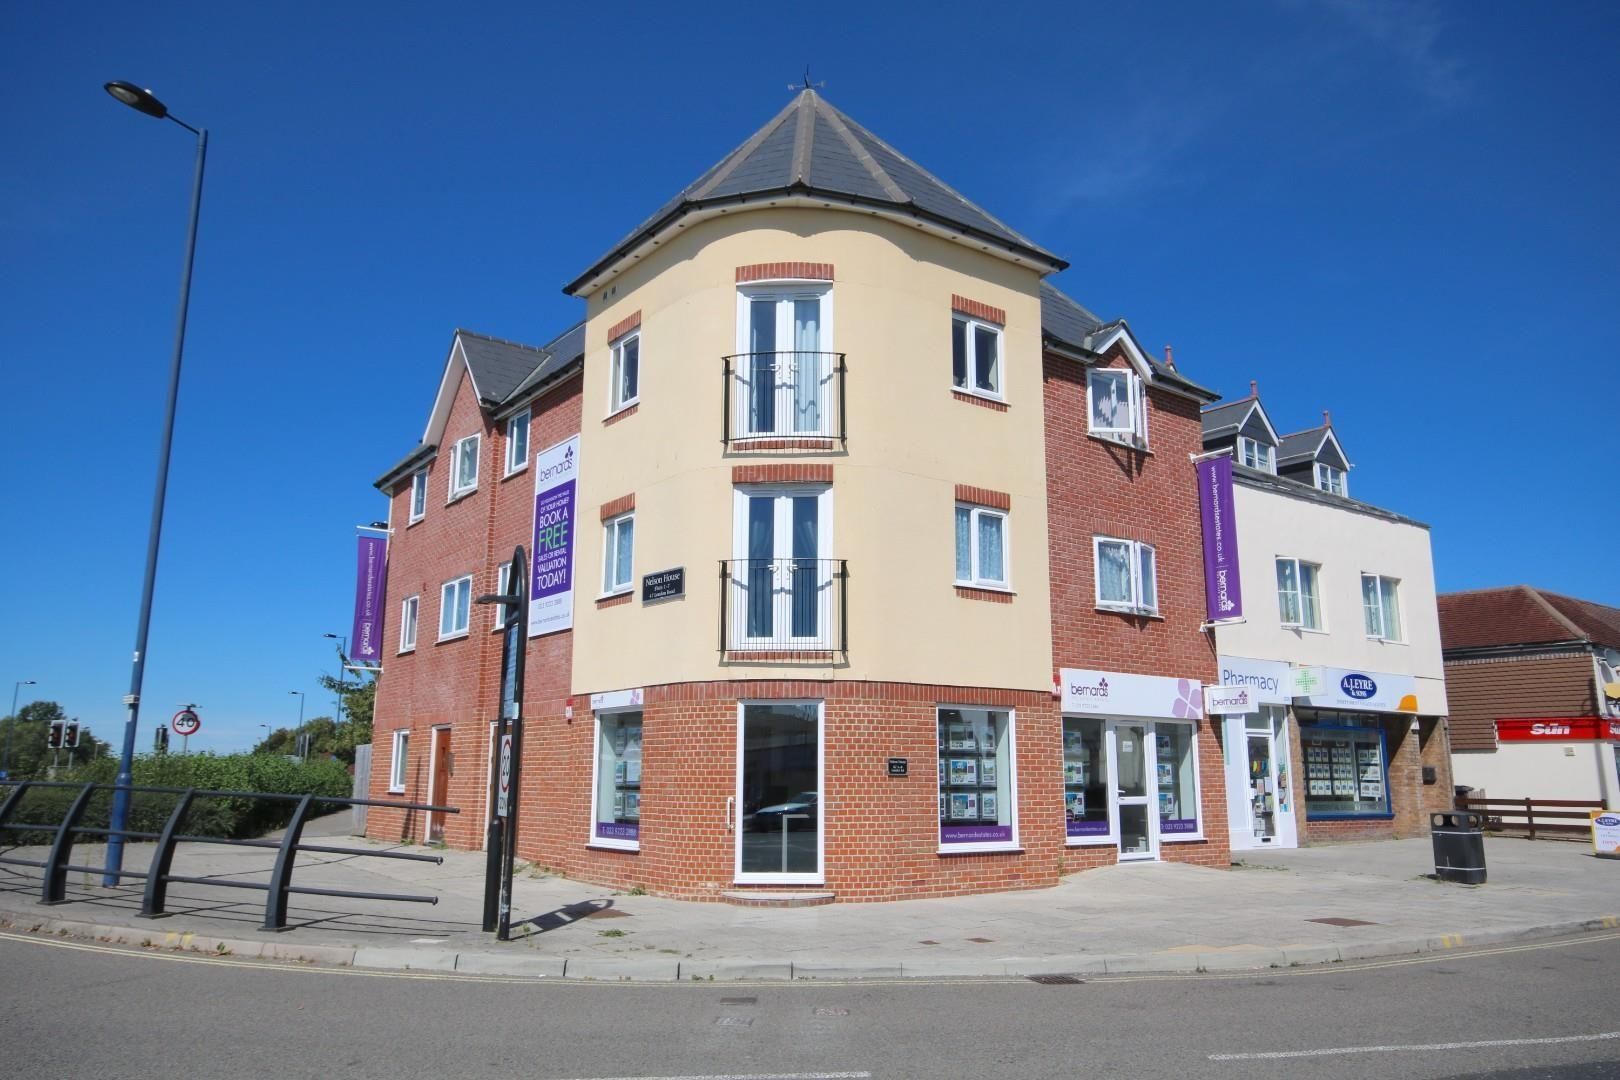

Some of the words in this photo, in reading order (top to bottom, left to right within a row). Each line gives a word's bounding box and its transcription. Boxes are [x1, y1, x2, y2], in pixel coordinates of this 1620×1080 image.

[540, 458, 573, 481] bernards
[540, 509, 561, 529] BOOK
[562, 506, 568, 521] A
[538, 521, 568, 554] FREE
[537, 556, 567, 574] VALUATION
[537, 569, 566, 590] TODAY!
[664, 574, 680, 582] House
[1071, 682, 1109, 697] bernards
[1223, 669, 1278, 694] Pharmacy
[1212, 696, 1248, 706] bernards
[176, 717, 195, 727] 40
[1530, 724, 1570, 735] Sun
